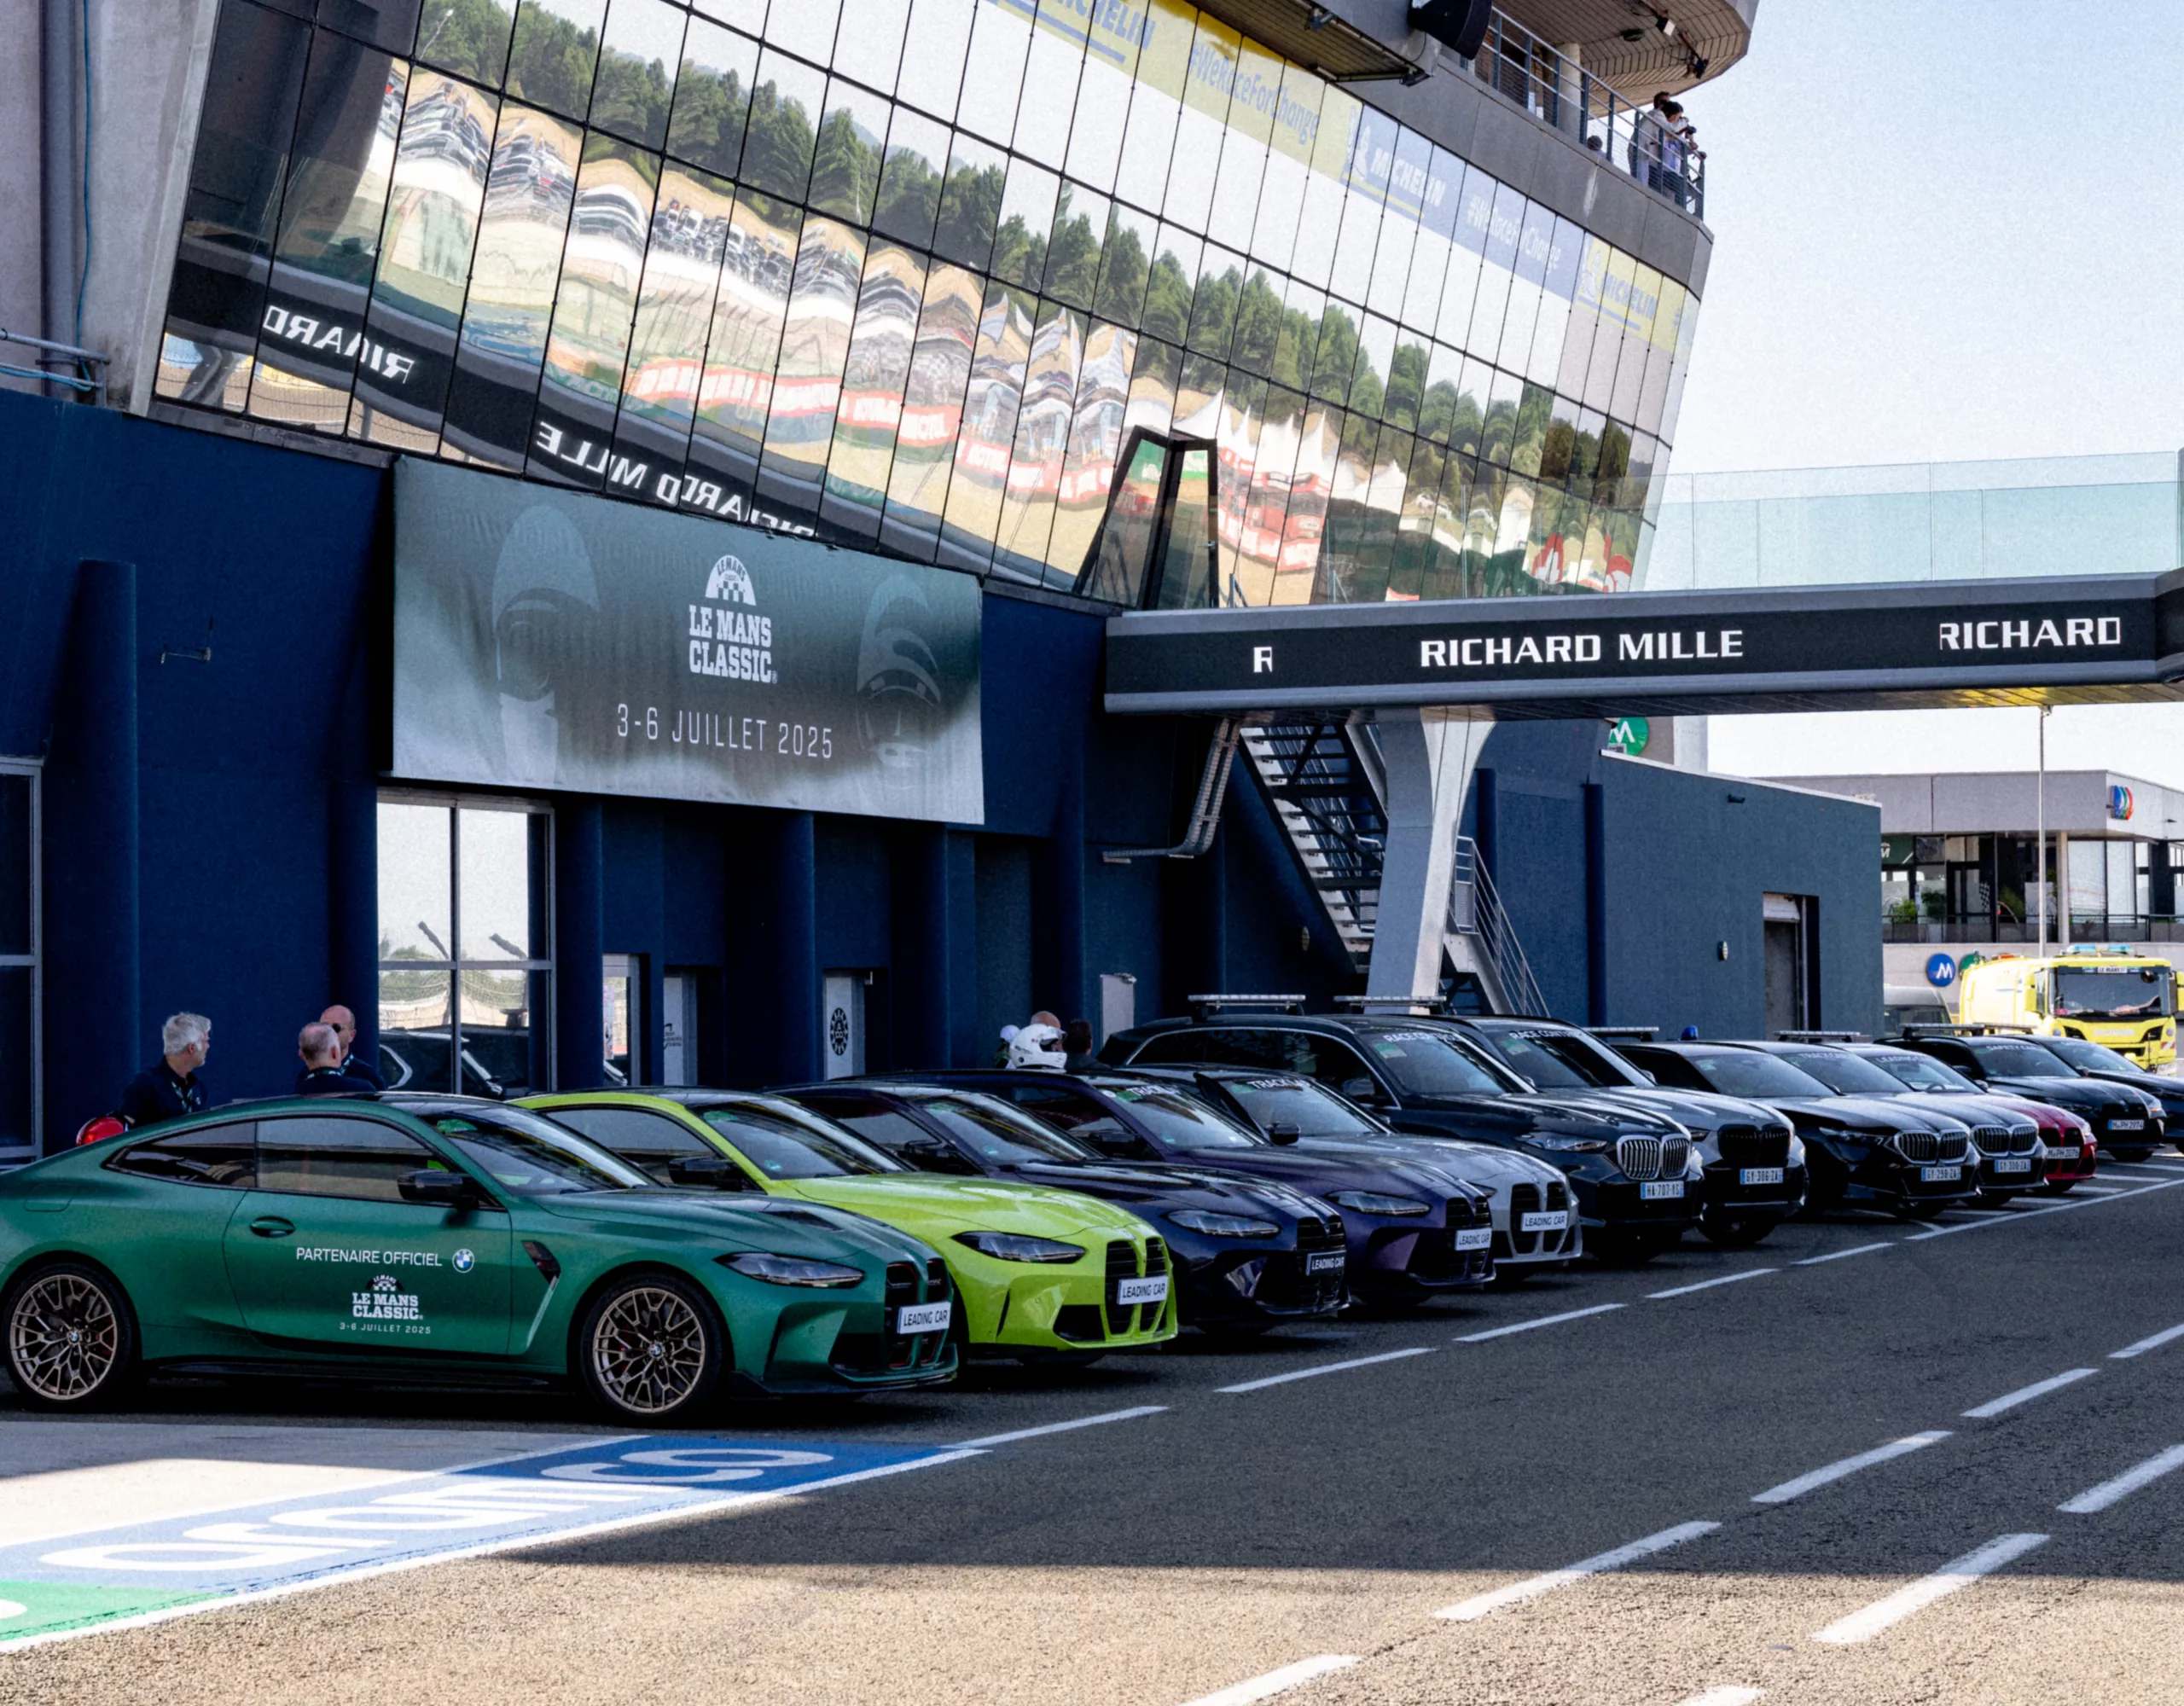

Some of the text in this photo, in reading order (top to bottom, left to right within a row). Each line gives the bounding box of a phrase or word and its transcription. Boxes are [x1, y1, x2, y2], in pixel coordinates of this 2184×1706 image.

[1056, 0, 1156, 51] CHELIN
[1370, 148, 1447, 208] MICHELIN
[688, 604, 772, 647] LE MANS
[1420, 635, 1600, 667] RICHARD
[1619, 630, 1743, 661] MILLE
[1939, 617, 2121, 650] RICHARD
[688, 640, 772, 683] CLASSIC
[617, 703, 833, 759] 3-6 JUILLET 2025
[1383, 1032, 1412, 1042] RACE
[1508, 1030, 1536, 1040] RACE
[1524, 1214, 1566, 1228] LEADING CAR
[1457, 1230, 1490, 1245] LEADING CAR
[296, 1247, 380, 1264] PARTENAIRE
[383, 1250, 443, 1267] OFFICIEL
[1311, 1255, 1345, 1270] LEADING CAR
[1122, 1282, 1166, 1298] LEADING CAR
[352, 1292, 418, 1307] LE MANS
[352, 1304, 419, 1320] CLASSIC
[903, 1309, 948, 1326] LEADING CAR
[340, 1322, 431, 1334] 3-6 JUILLET 2025
